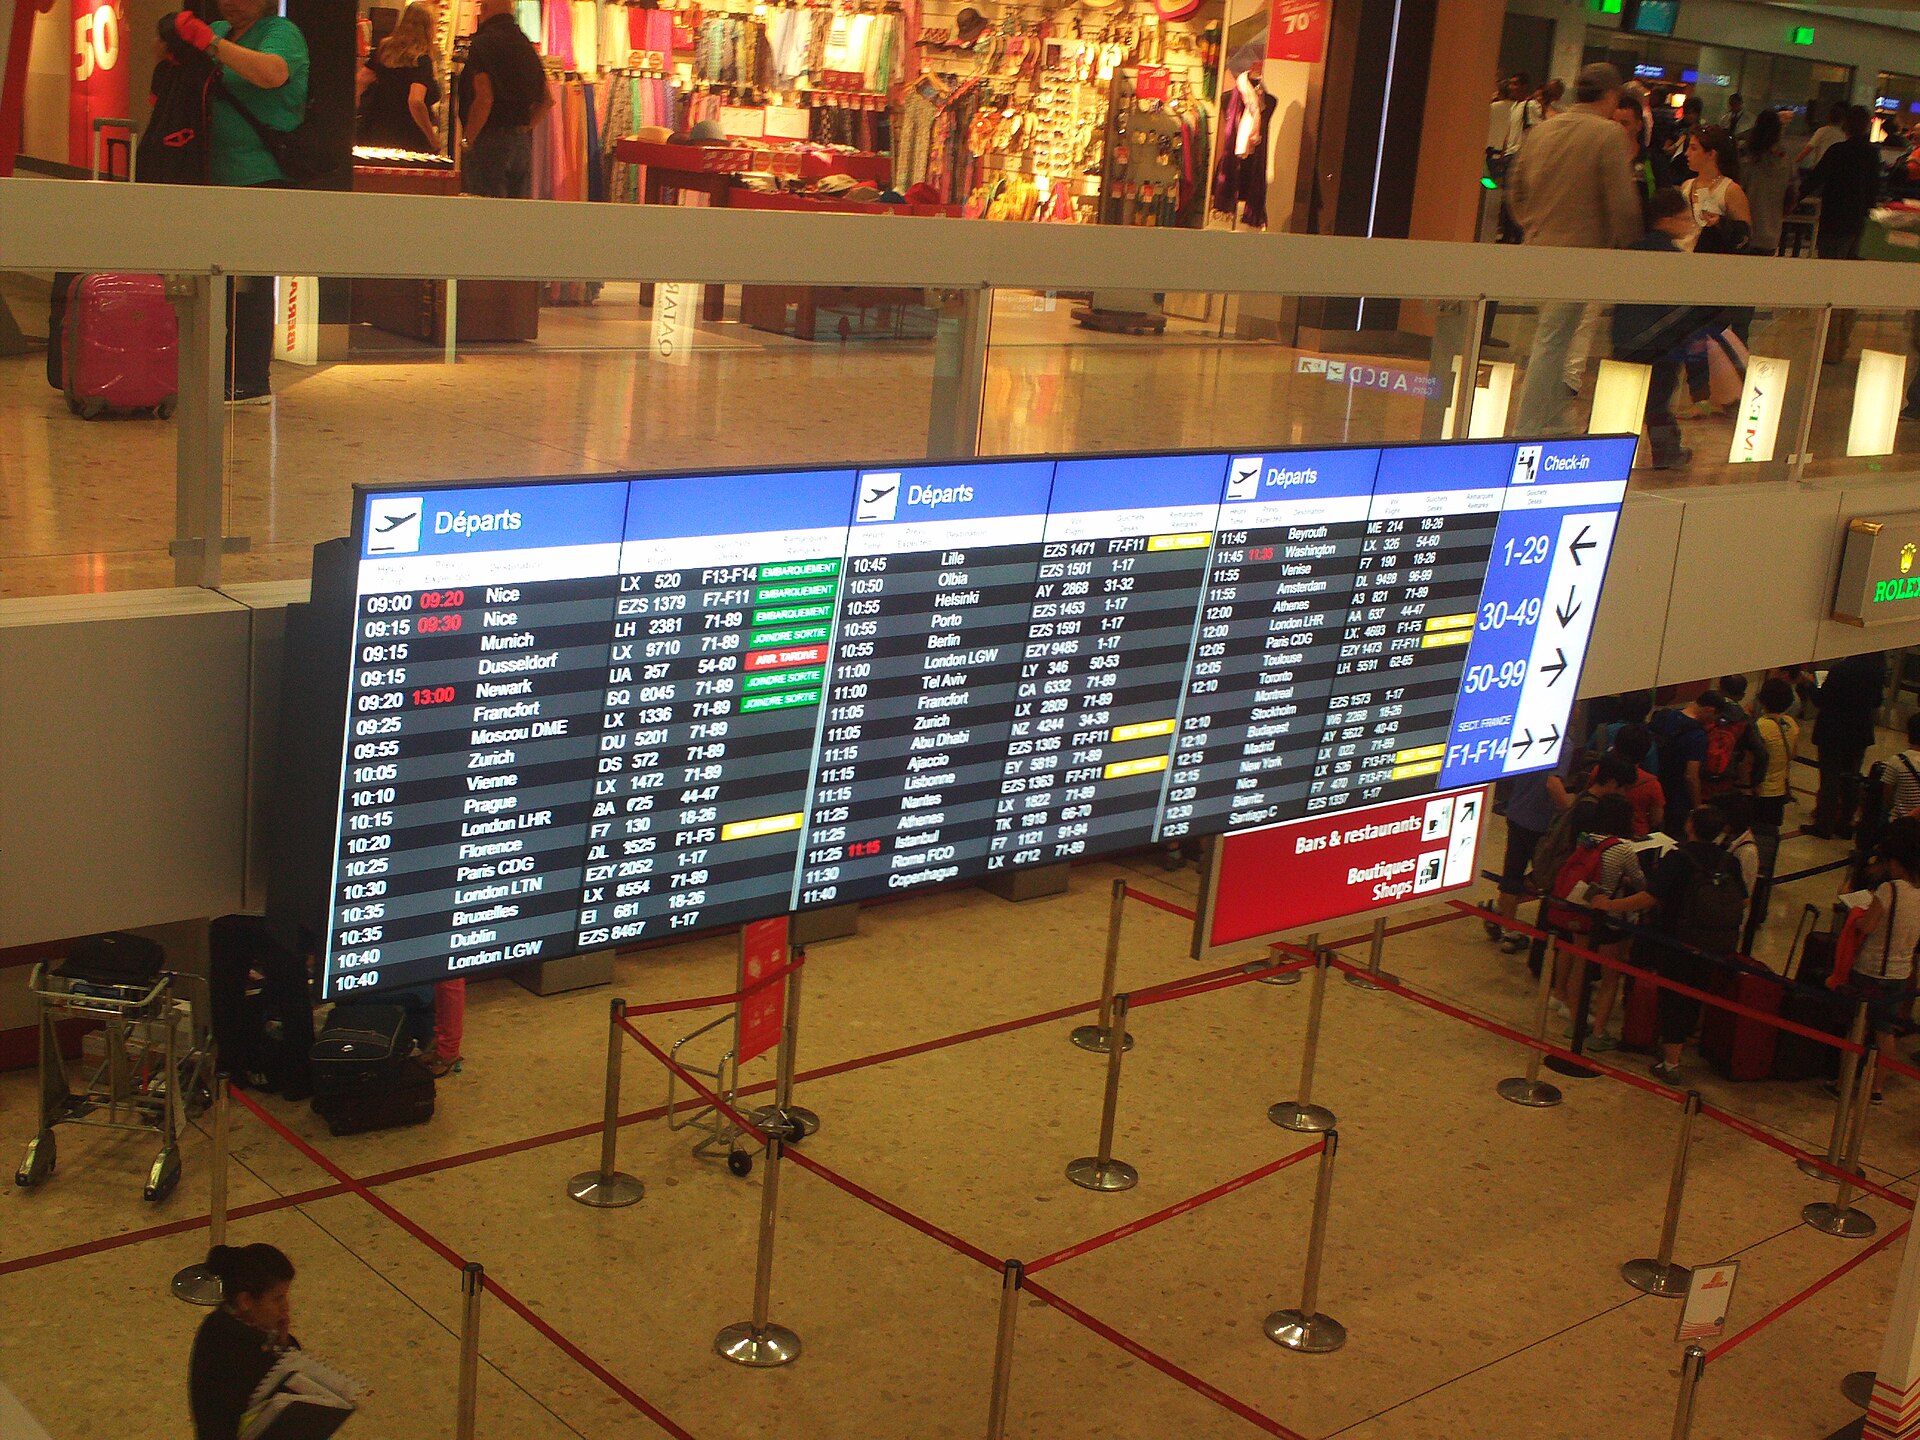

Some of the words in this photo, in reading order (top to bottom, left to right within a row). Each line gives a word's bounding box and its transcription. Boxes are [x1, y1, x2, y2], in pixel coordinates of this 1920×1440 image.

[1265, 468, 1318, 489] Départs
[1544, 455, 1590, 472] Check-in
[907, 484, 974, 508] Départs
[434, 509, 522, 537] Départs
[1222, 531, 1248, 544] 11:45
[1288, 526, 1328, 542] Beyrouth
[1367, 521, 1383, 534] ME
[854, 557, 887, 573] 10:45
[941, 551, 965, 565] Lille
[1043, 543, 1068, 558] EZS
[1071, 542, 1095, 556] 1471
[1108, 538, 1145, 553] F7-F11
[1218, 550, 1244, 563] 11:45
[1285, 544, 1336, 558] Washington
[1504, 535, 1549, 567] 1-29
[851, 578, 883, 594] 10:50
[938, 572, 968, 586] Olbia
[1039, 563, 1064, 578] EZS
[1067, 561, 1092, 575] 1501
[1112, 558, 1135, 572] 1-17
[1214, 568, 1240, 582] 11:55
[1282, 563, 1312, 576] Venise
[1359, 557, 1373, 569] F7
[367, 594, 412, 613] 09:00
[420, 590, 464, 609] 09:20
[486, 587, 520, 603] Nice
[621, 576, 641, 591] LX
[654, 573, 681, 589] 520
[702, 567, 757, 585] F13-F14
[762, 563, 836, 577] EMBARQUEMENT
[847, 600, 880, 615] 10:55
[934, 591, 980, 607] Helsinki
[1035, 584, 1054, 598] AY
[1210, 587, 1236, 601] 11:55
[1276, 580, 1327, 594] Amsterdam
[365, 619, 410, 638] 09:15
[418, 615, 462, 632] 09:30
[483, 611, 517, 627] Nice
[618, 598, 648, 614] EZS
[654, 595, 686, 611] 1379
[703, 589, 749, 607] F7-F11
[759, 585, 833, 599] EMBARQUEMENT
[844, 621, 877, 637] 10:55
[931, 614, 962, 628] Porto
[1478, 597, 1541, 631] 30-49
[363, 644, 408, 662] 09:15
[481, 632, 534, 651] Munich
[615, 622, 636, 638] LH
[756, 606, 830, 621] EMBARQUEMENT
[841, 642, 874, 658] 10:55
[927, 633, 961, 648] Berlin
[360, 668, 405, 687] 09:15
[478, 652, 558, 675] Dusseldorf
[612, 645, 633, 660] LX
[838, 663, 870, 679] 11:00
[924, 653, 966, 669] London
[968, 648, 998, 664] LGW
[1464, 659, 1527, 694] 50-99
[359, 692, 403, 711] 09:20
[413, 686, 455, 705] 13:00
[476, 679, 533, 698] Newark
[834, 684, 867, 700] 11:00
[922, 675, 941, 689] Tel
[941, 672, 967, 687] Aviv
[356, 716, 401, 735] 09:25
[474, 701, 540, 722] Francfort
[831, 705, 864, 721] 11:05
[918, 692, 969, 709] Francfort
[354, 740, 399, 759] 09:55
[471, 728, 528, 745] Moscou
[531, 719, 568, 737] DME
[604, 712, 625, 728] LX
[828, 725, 861, 741] 11:05
[913, 714, 950, 730] Zurich
[354, 764, 397, 782] 10:05
[468, 749, 515, 768] Zurich
[1445, 737, 1509, 769] F1-F14
[349, 811, 393, 830] 10:15
[464, 797, 517, 814] Prague
[596, 779, 617, 795] LX
[352, 788, 395, 806] 10:10
[466, 774, 518, 791] Vienne
[347, 834, 390, 853] 10:20
[461, 818, 515, 837] London
[518, 811, 551, 828] LHR
[1295, 835, 1327, 855] Bars
[1328, 831, 1342, 847] &
[1343, 815, 1422, 845] restaurants
[346, 858, 389, 876] 10:25
[459, 840, 523, 859] Florence
[591, 823, 611, 838] F7
[342, 903, 384, 923] 10:35
[455, 885, 509, 904] London
[511, 877, 542, 895] LTN
[585, 864, 617, 882] EZY
[678, 849, 708, 866] 1-17
[344, 880, 386, 899] 10:30
[457, 864, 495, 881] Paris
[497, 857, 534, 875] CDG
[1347, 857, 1416, 885] Boutiques
[1372, 879, 1413, 901] Shops
[340, 926, 382, 945] 10:35
[452, 905, 519, 926] Bruxelles
[336, 971, 377, 991] 10:40
[448, 951, 501, 970] London
[504, 940, 542, 959] LGW
[578, 928, 609, 945] EZS
[670, 911, 699, 928] 1-17
[338, 949, 380, 968] 10:40
[450, 929, 496, 948] Dublin
